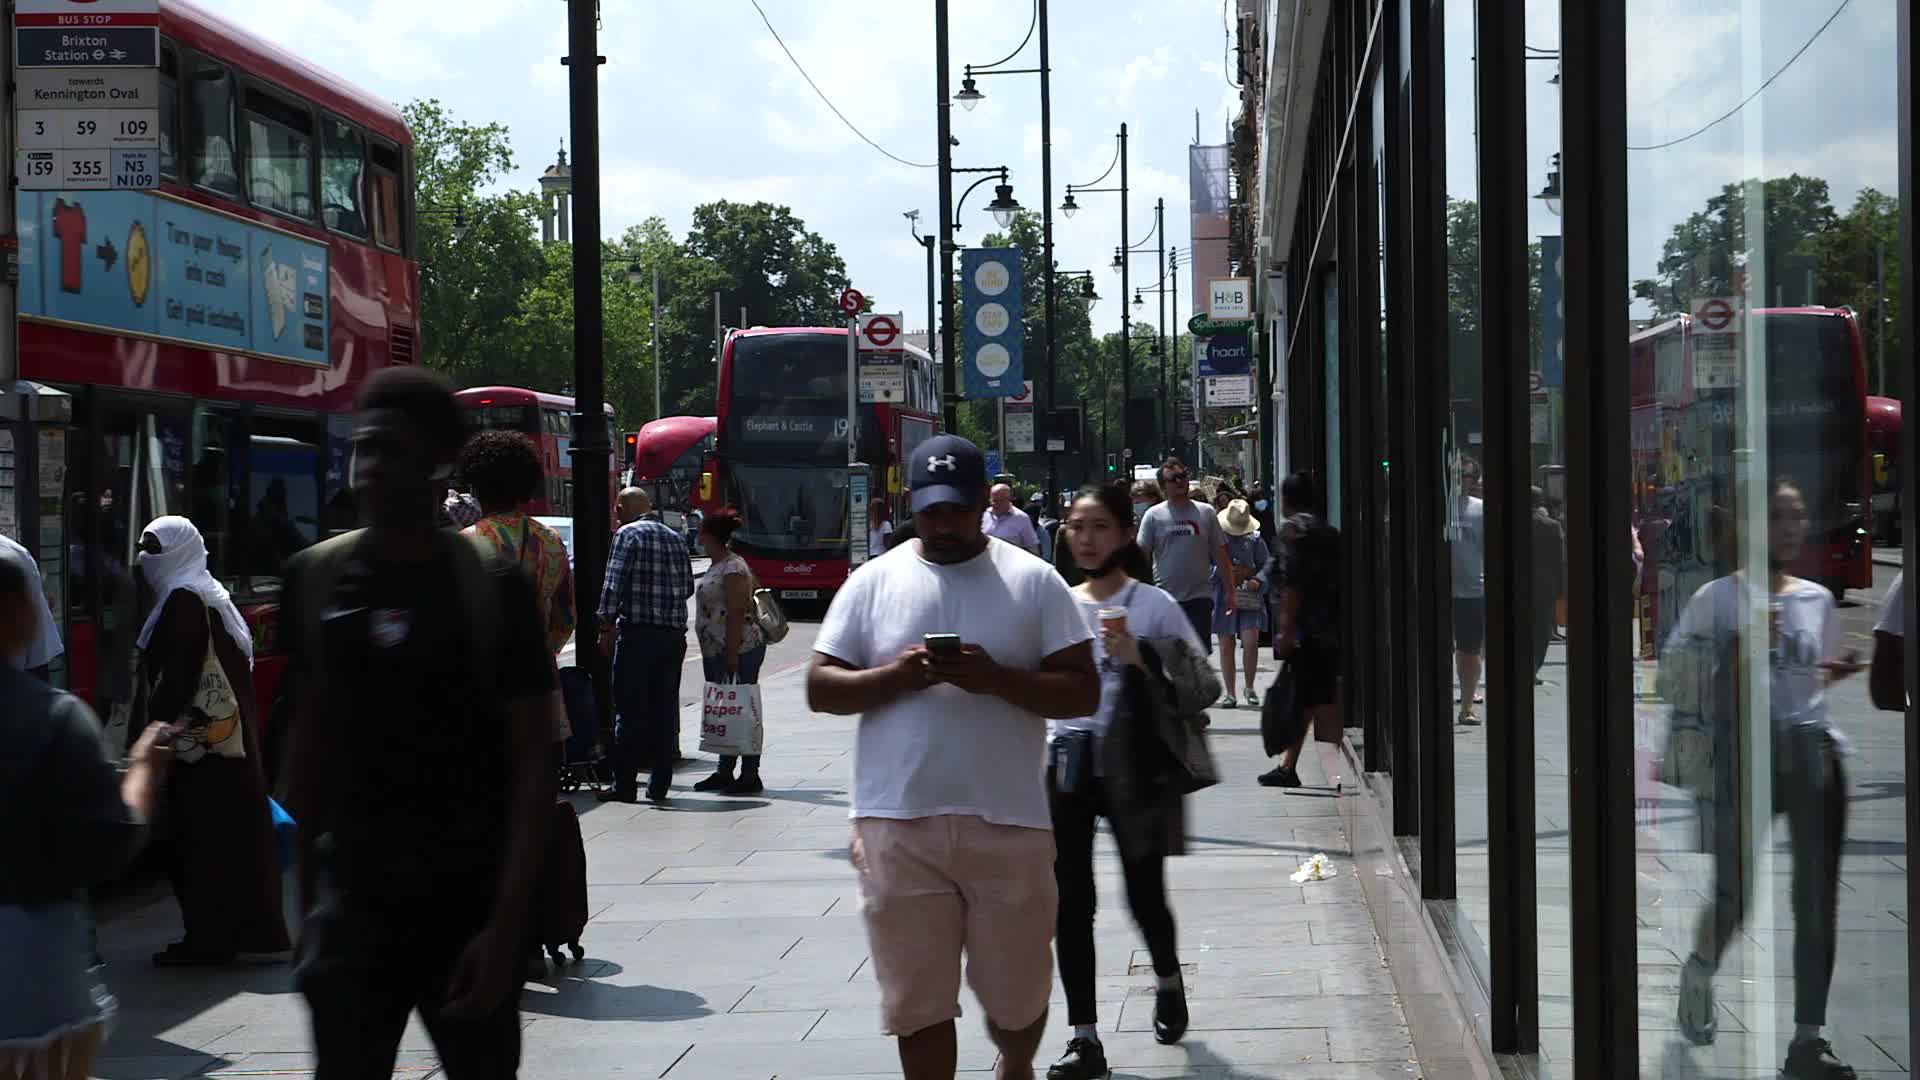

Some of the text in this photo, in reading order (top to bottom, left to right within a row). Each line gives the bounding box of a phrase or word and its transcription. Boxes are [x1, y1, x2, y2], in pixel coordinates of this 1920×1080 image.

[58, 15, 112, 25] BUS STOP
[62, 35, 107, 46] Brixton
[45, 50, 89, 61] Station
[68, 77, 104, 86] towards
[34, 88, 139, 101] Kennington Oval
[35, 121, 45, 136] 3
[77, 121, 97, 135] 59
[120, 121, 148, 135] 109
[27, 161, 54, 176] 159
[72, 161, 102, 176] 355
[125, 161, 145, 173] N3
[117, 175, 152, 187] N109
[846, 291, 858, 310] S
[1212, 346, 1246, 358] haart
[746, 418, 814, 433] Elephant & Castle
